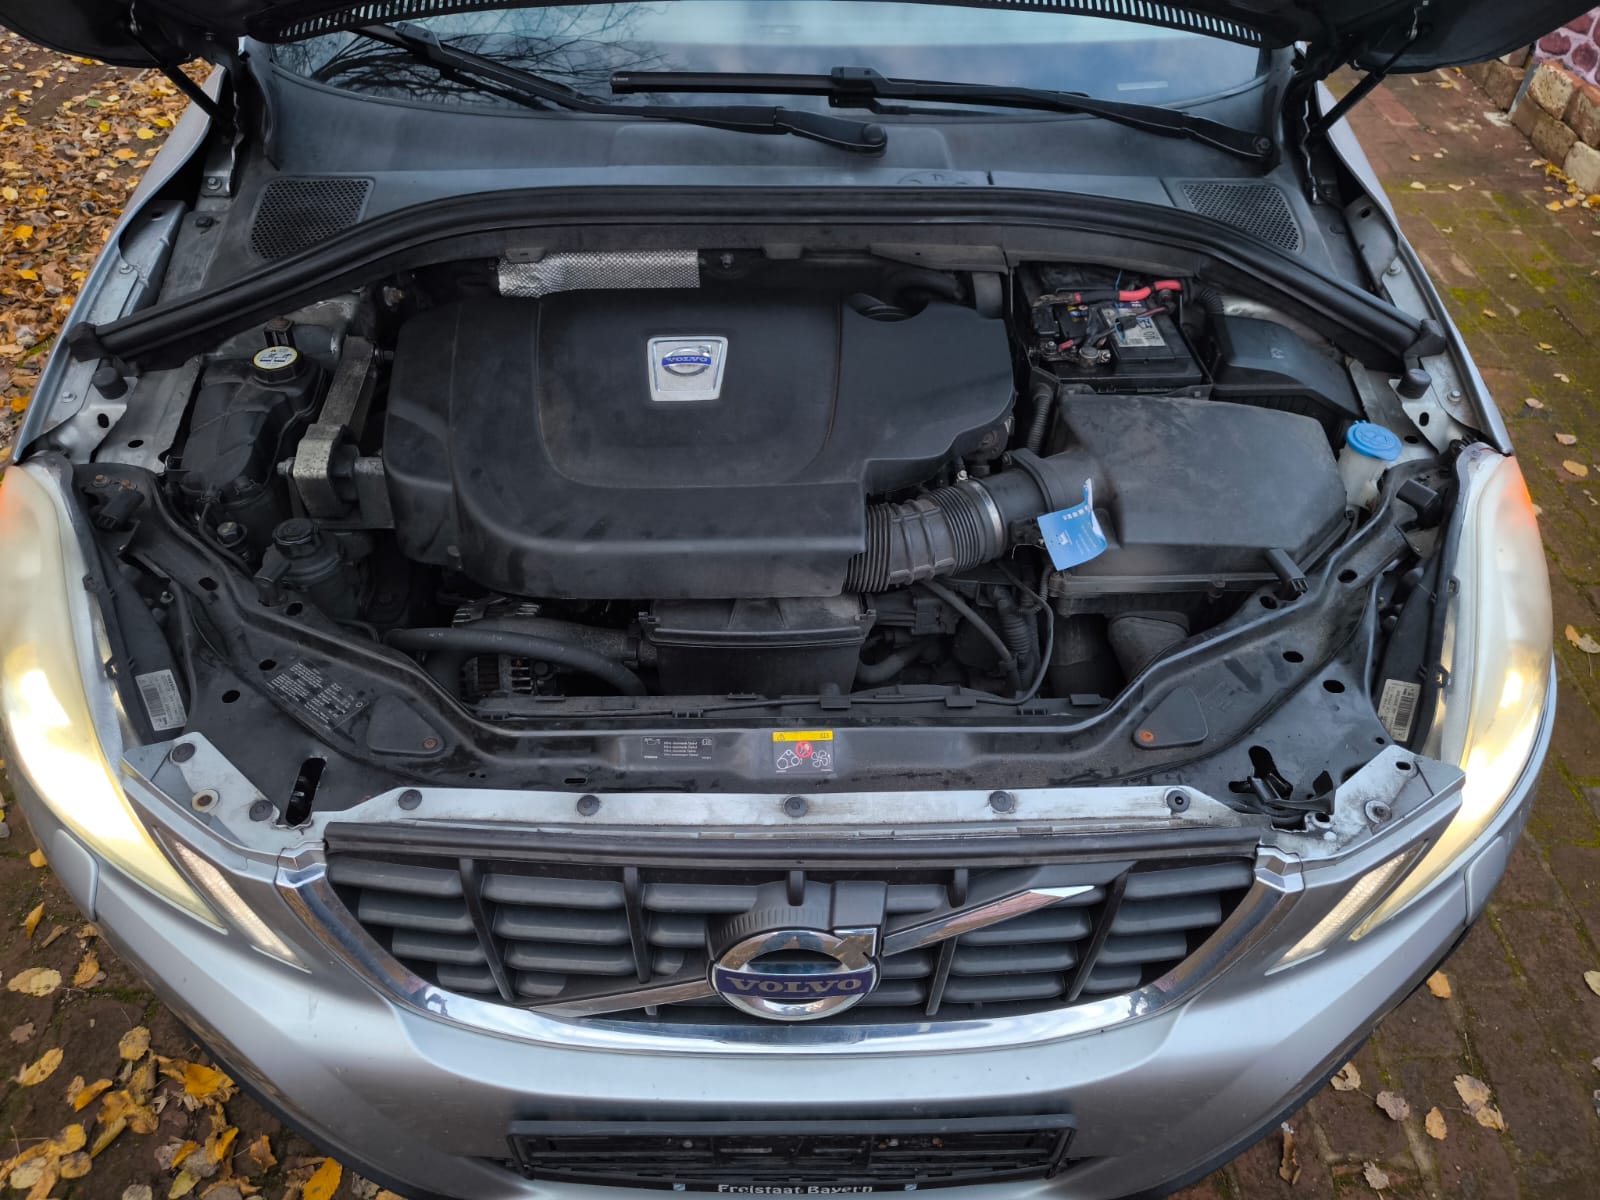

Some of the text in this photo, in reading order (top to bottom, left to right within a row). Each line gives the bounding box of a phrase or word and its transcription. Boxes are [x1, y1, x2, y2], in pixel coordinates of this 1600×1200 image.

[726, 977, 862, 993] VOLVO
[718, 1184, 873, 1194] Freistaat Bayern
